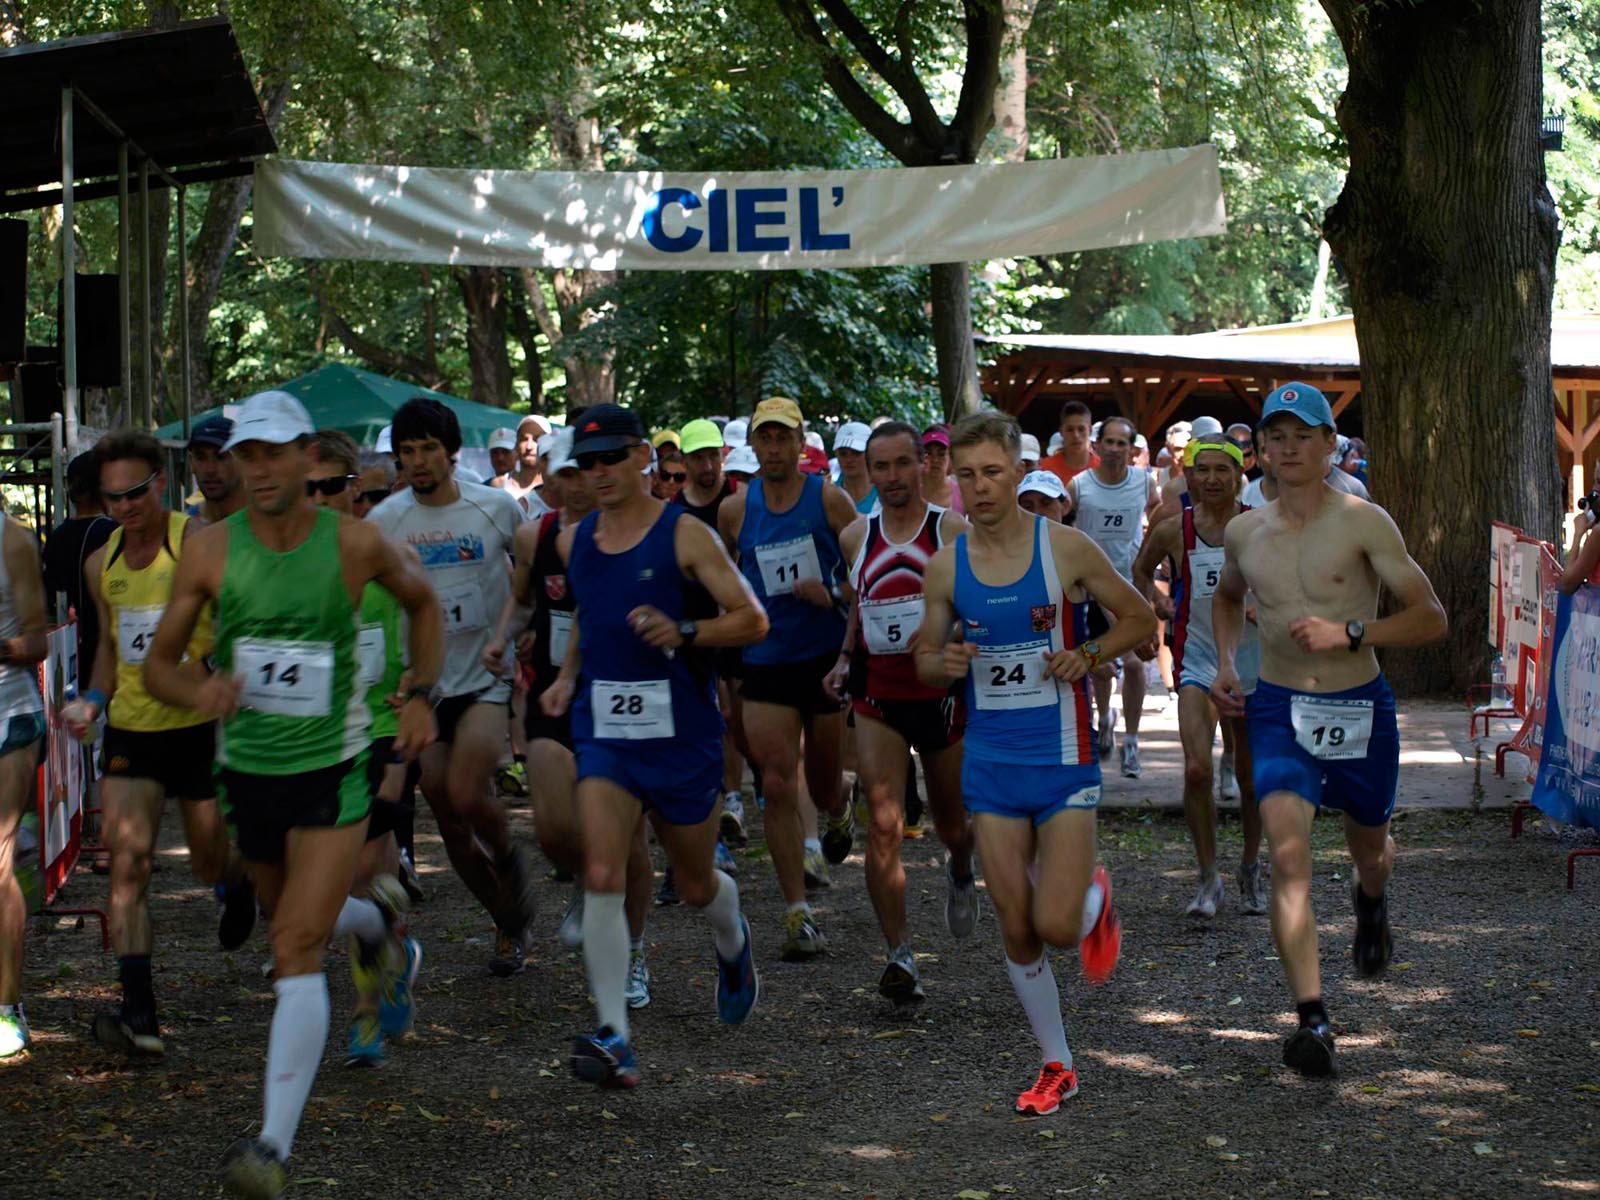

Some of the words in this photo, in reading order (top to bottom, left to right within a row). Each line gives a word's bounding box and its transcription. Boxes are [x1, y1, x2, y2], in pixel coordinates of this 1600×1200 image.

[1103, 515, 1124, 527] 78
[776, 562, 799, 583] 11
[1206, 570, 1222, 587] 5
[887, 623, 902, 643] 5
[258, 661, 303, 687] 14
[989, 663, 1027, 687] 24
[609, 694, 643, 715] 28
[1311, 726, 1346, 747] 19
